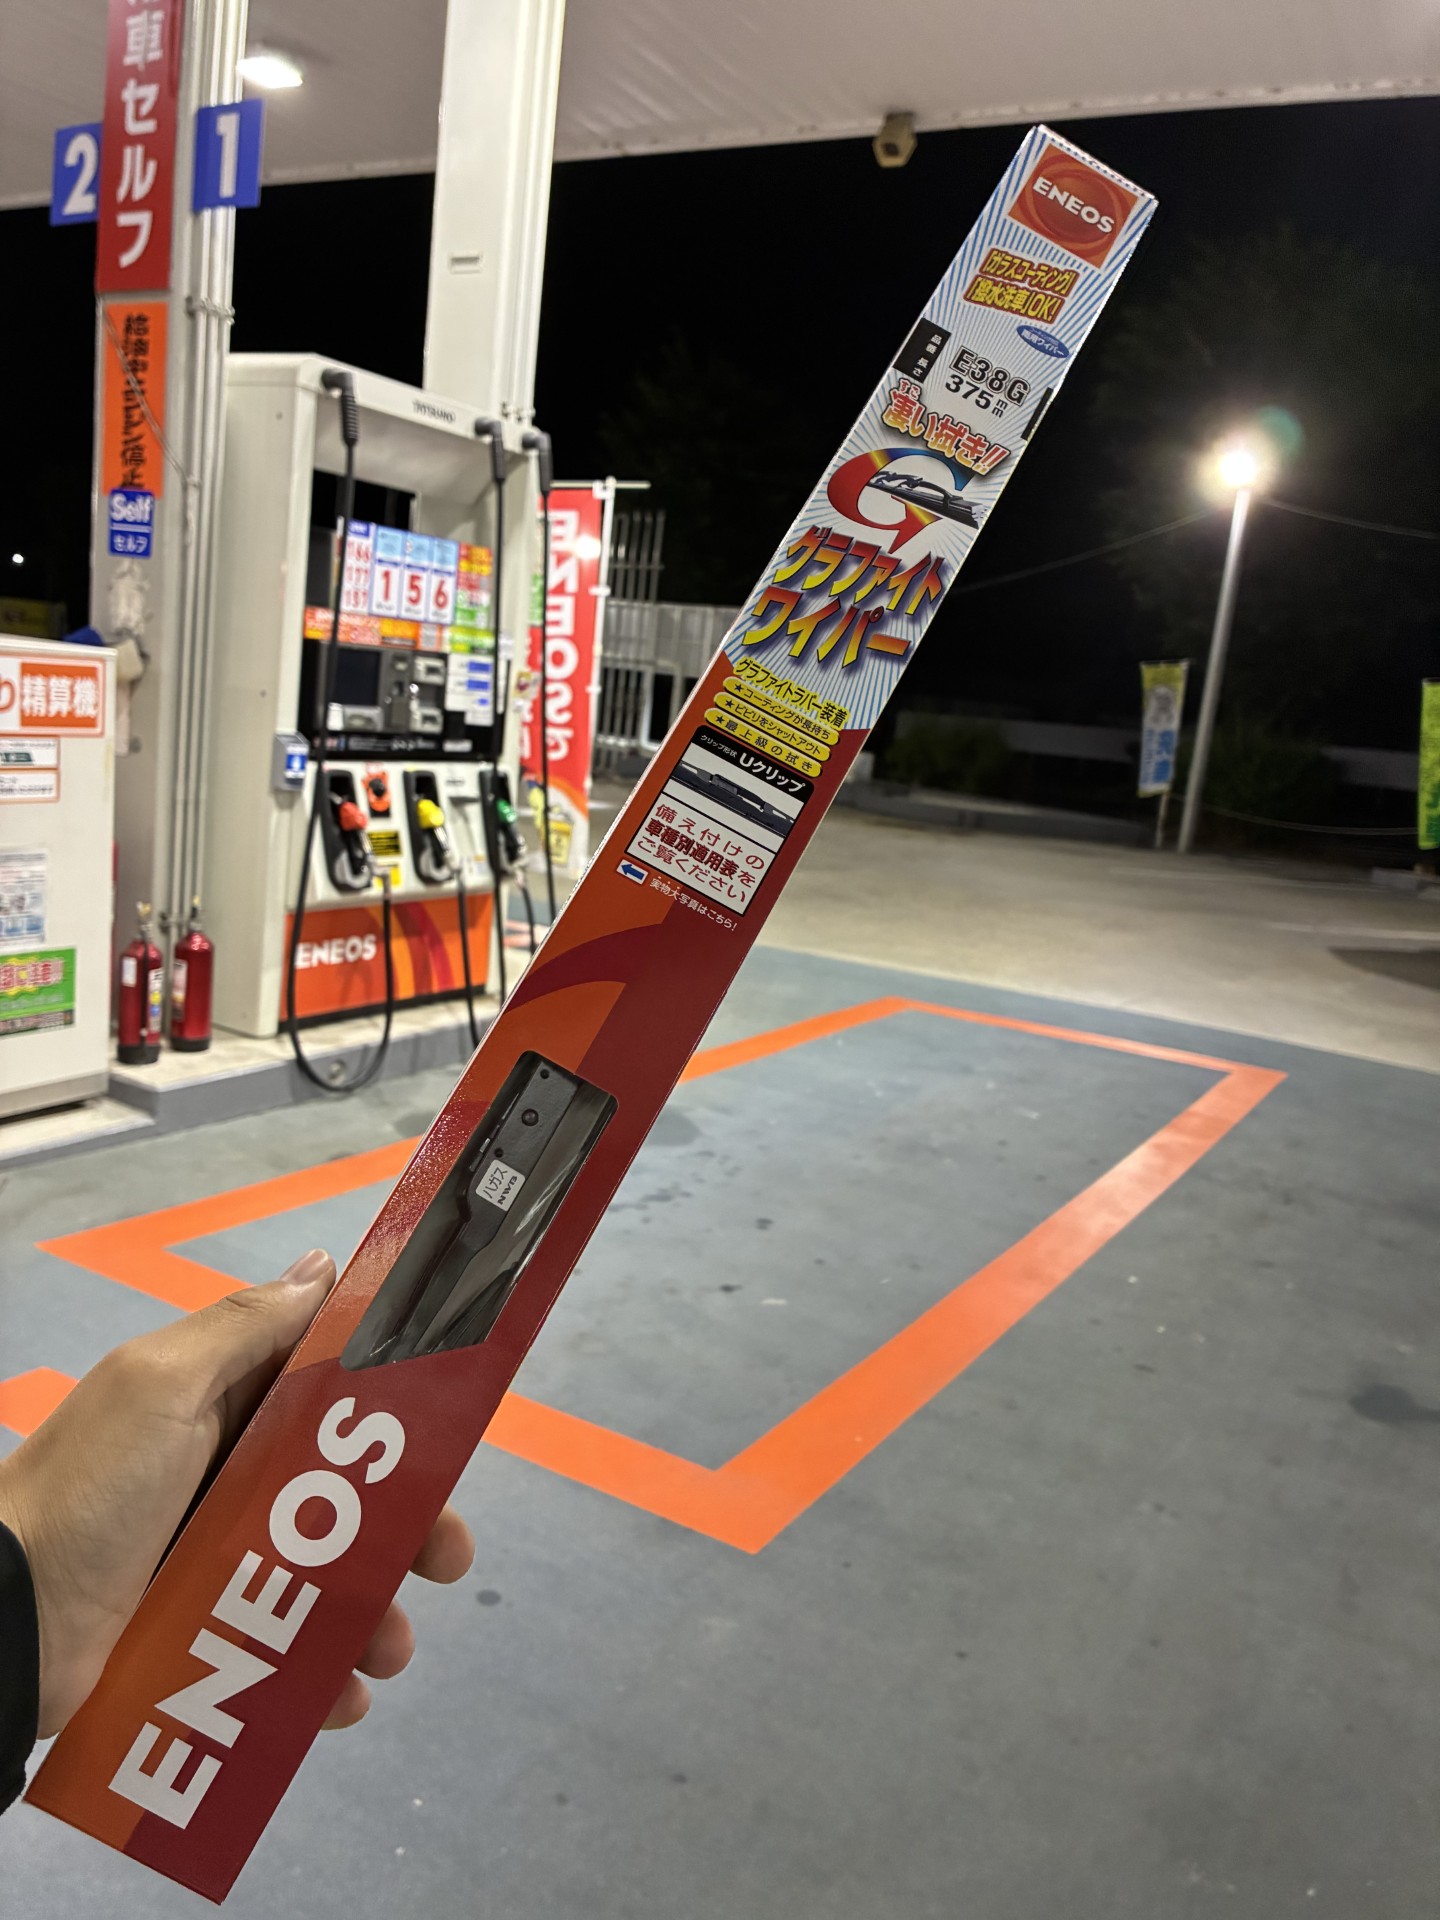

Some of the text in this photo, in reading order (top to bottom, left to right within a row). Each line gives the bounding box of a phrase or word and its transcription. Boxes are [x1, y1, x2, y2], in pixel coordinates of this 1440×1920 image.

[114, 0, 165, 269] 車セルフ
[216, 112, 241, 198] 1
[62, 132, 98, 216] 2
[1032, 176, 1115, 233] ENEOS
[949, 345, 1031, 407] E38G
[110, 492, 154, 523] Self
[113, 533, 149, 553] セルフ
[772, 524, 945, 615] グラファイト
[741, 584, 912, 669] ワイパー
[22, 673, 98, 719] 精算機
[735, 657, 848, 728] グラファイトラバー装着
[743, 688, 832, 740] コーティングが長持ち
[734, 703, 821, 754] ビビリをシャットアウト
[738, 751, 806, 793] Uクリップ
[644, 817, 756, 889] 車種別適用表を
[656, 803, 765, 870] 備え付けの
[637, 835, 746, 903] ご覧ください
[294, 934, 377, 970] ENEOS
[496, 1175, 519, 1206] NWB
[108, 1396, 406, 1830] ENEOS
